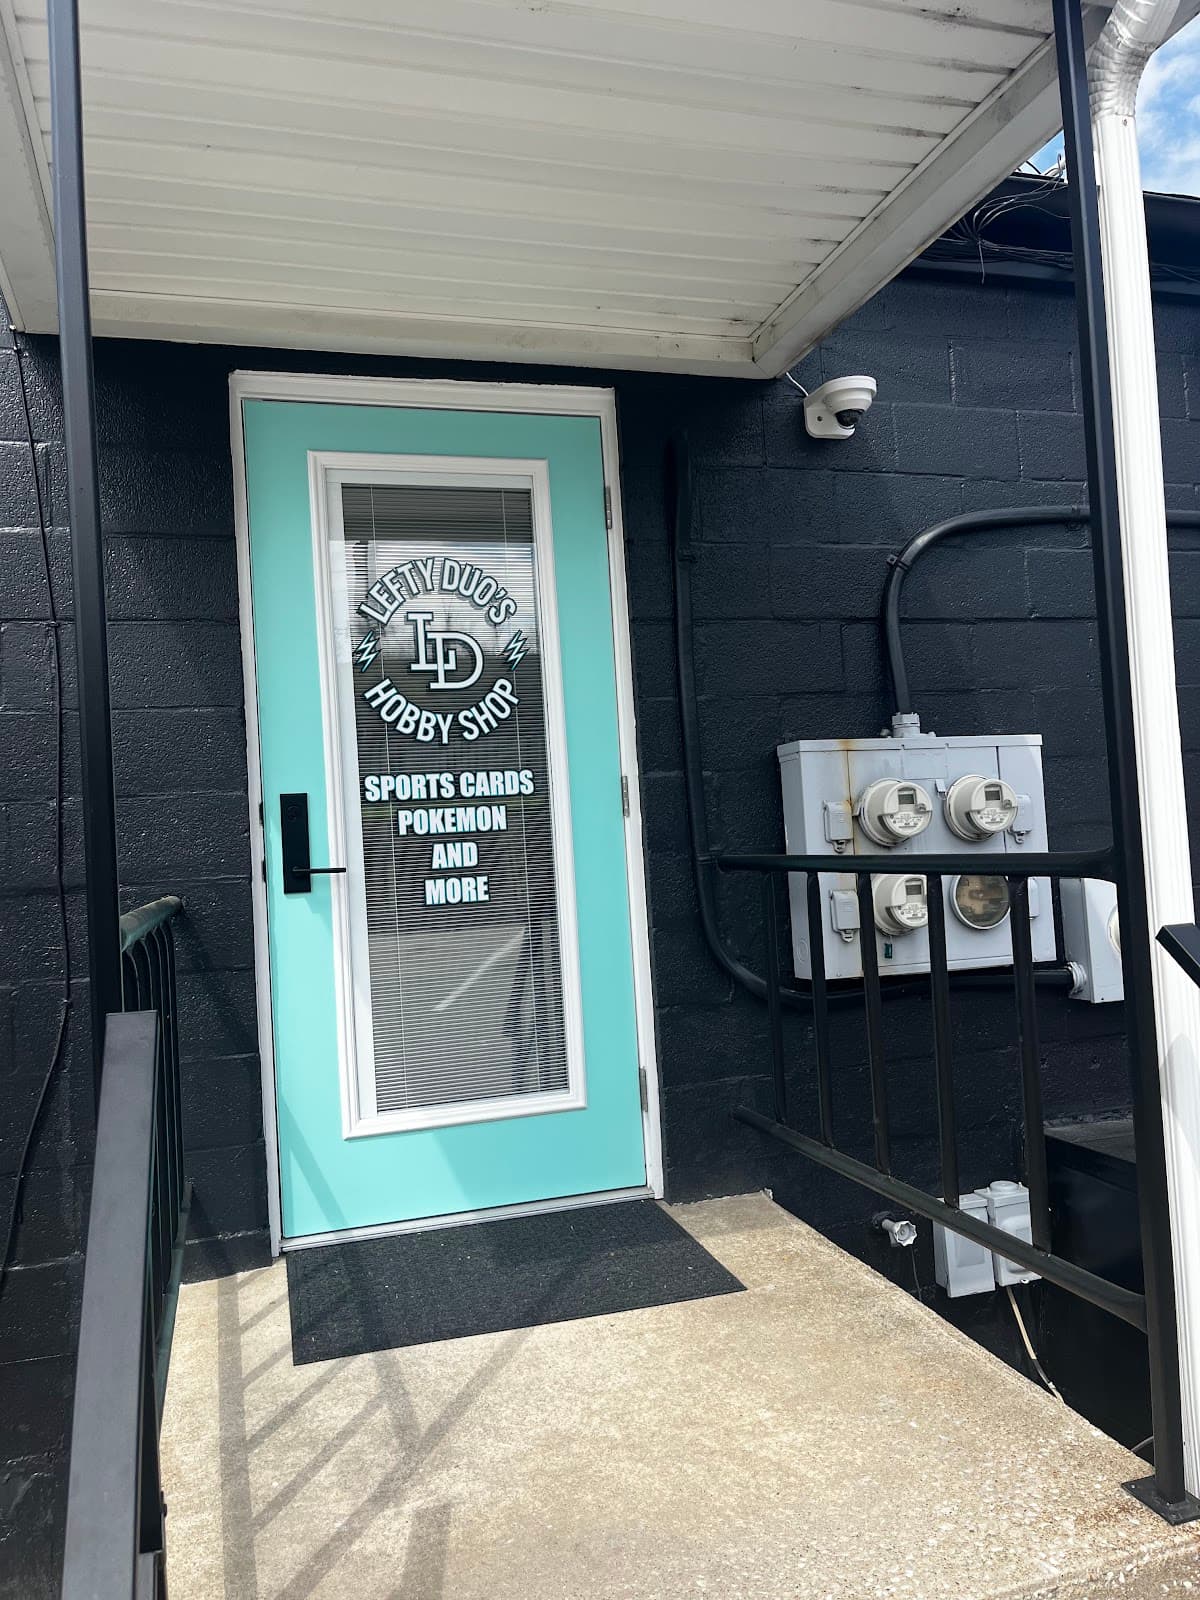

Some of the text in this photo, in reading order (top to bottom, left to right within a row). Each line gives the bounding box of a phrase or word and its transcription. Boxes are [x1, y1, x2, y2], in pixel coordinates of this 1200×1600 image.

[358, 557, 517, 625] LEFTY DUO'S
[363, 678, 519, 744] HOBBY SHOP
[364, 769, 535, 802] SPORTS CARDS
[398, 805, 508, 836] POKEMON
[431, 842, 479, 869] AND
[424, 876, 490, 905] MORE
